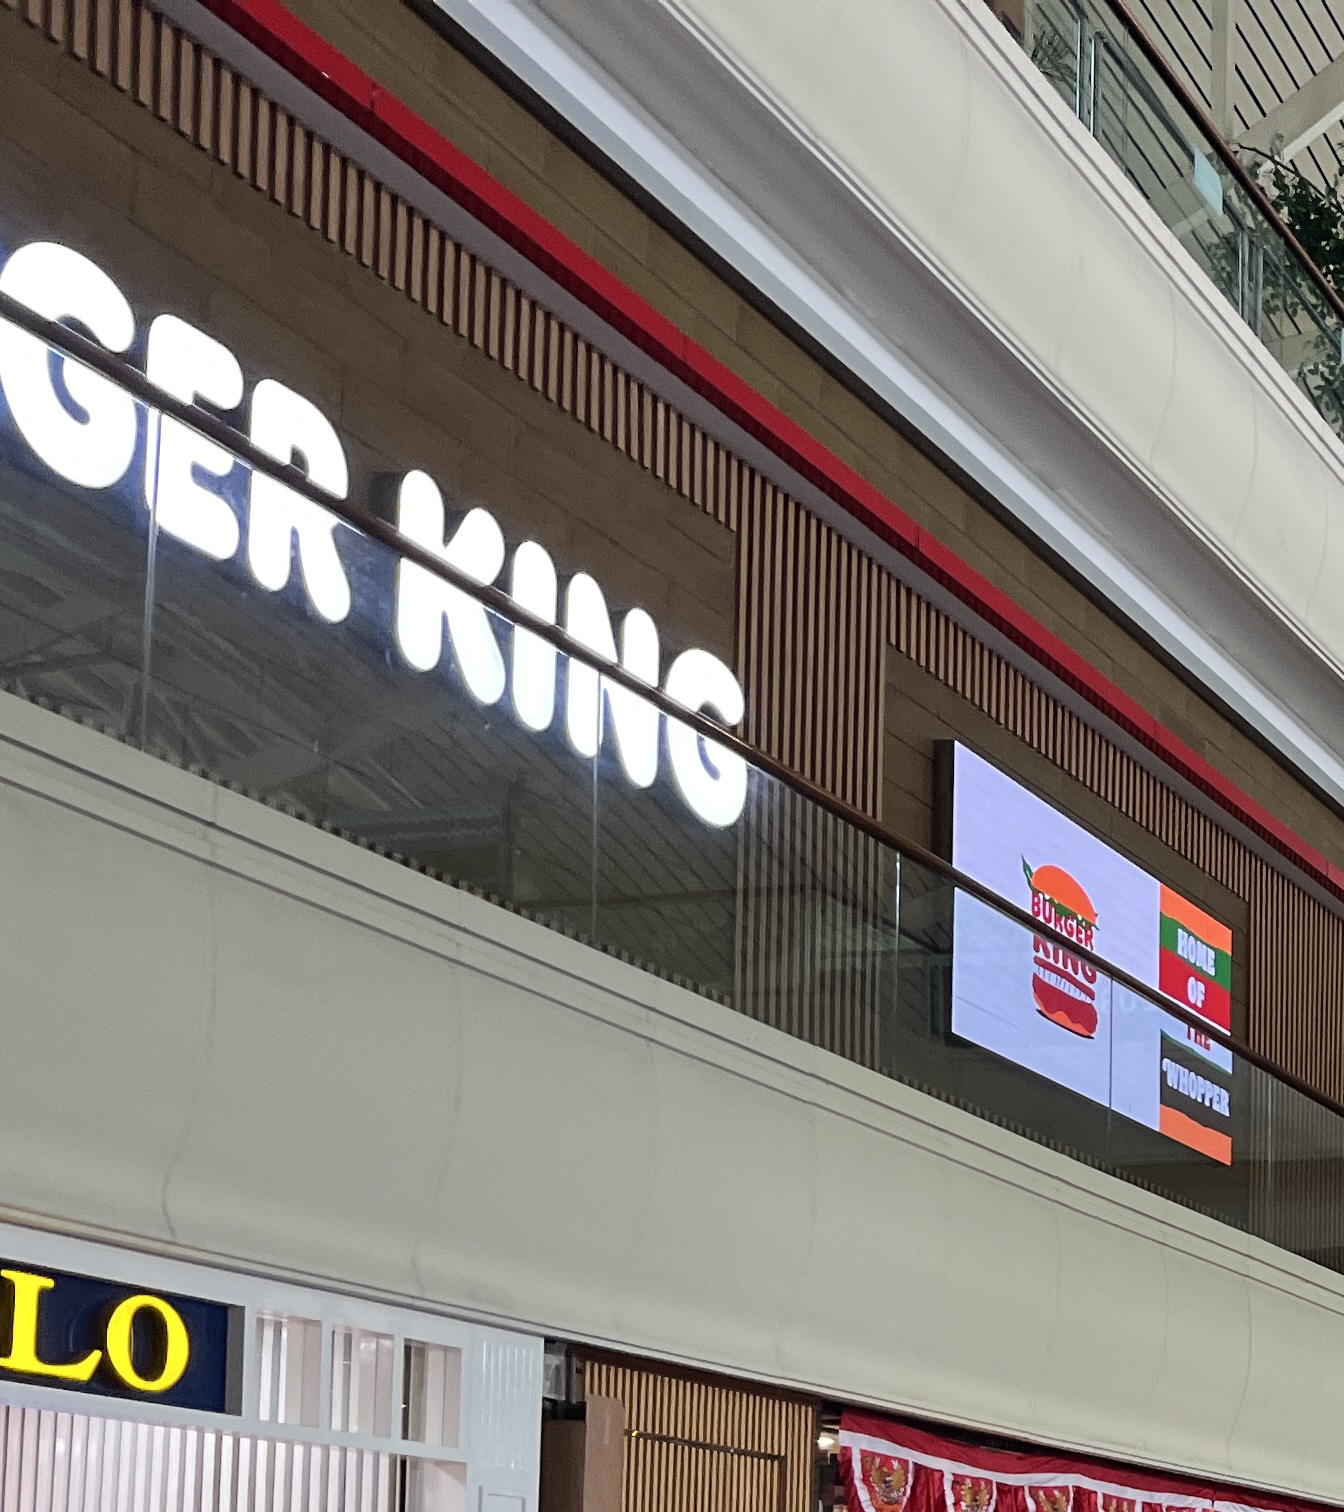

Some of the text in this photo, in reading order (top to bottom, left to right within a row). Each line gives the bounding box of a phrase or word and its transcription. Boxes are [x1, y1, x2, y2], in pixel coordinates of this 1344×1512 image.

[397, 469, 747, 828] KING
[1031, 890, 1094, 951] BURGER
[1177, 928, 1216, 976] HOME
[1187, 976, 1206, 1009] OF
[0, 1268, 191, 1393] LO
